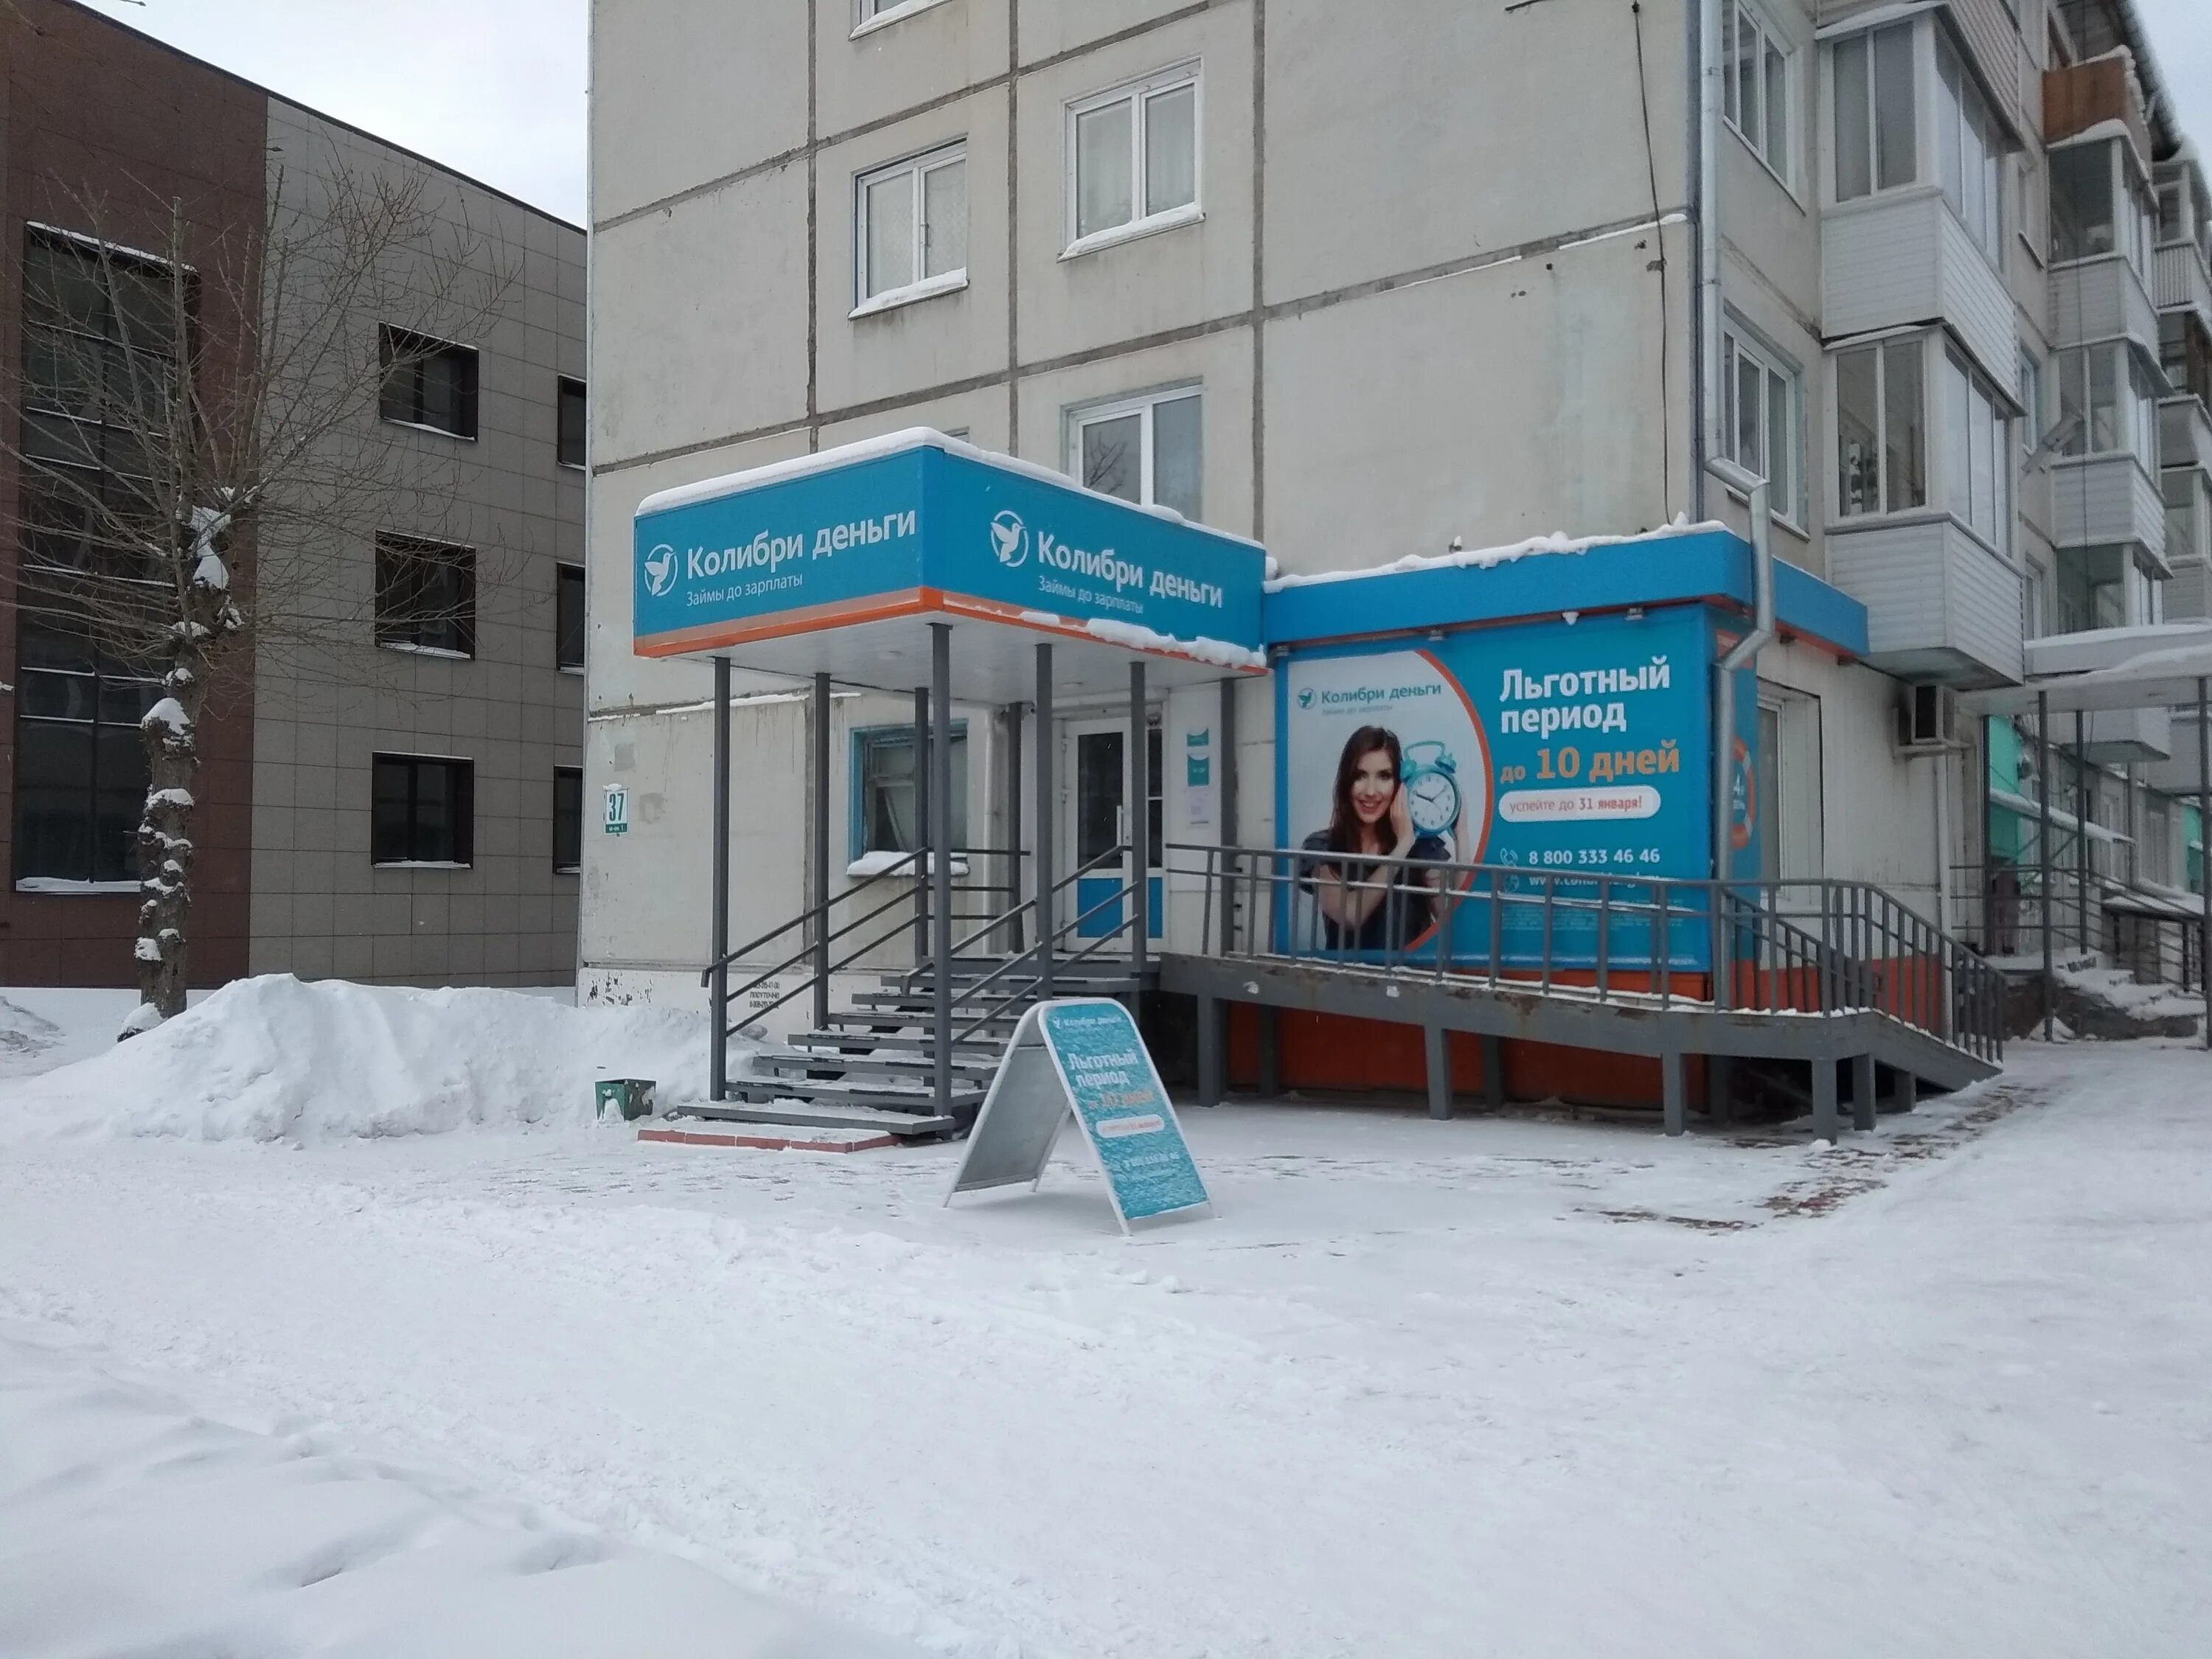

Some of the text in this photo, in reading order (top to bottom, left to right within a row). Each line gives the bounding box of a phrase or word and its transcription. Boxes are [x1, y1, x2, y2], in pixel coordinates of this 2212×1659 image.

[687, 509, 916, 580] Колибри деньги
[1037, 530, 1223, 609] Колибри деньги
[686, 573, 803, 607] Займы до зарплаты
[1038, 575, 1144, 614] Займы до зарплаты
[1321, 683, 1441, 704] Колибри деньги
[1499, 655, 1671, 702] Льготный
[1500, 703, 1627, 740] период
[1499, 739, 1680, 785] до 10 дней
[609, 793, 625, 821] 37
[1509, 796, 1642, 815] успейте до 31 января!
[1528, 848, 1660, 864] 8 800 333 46 46
[1068, 1048, 1138, 1070] Льготный
[1076, 1071, 1130, 1090] период
